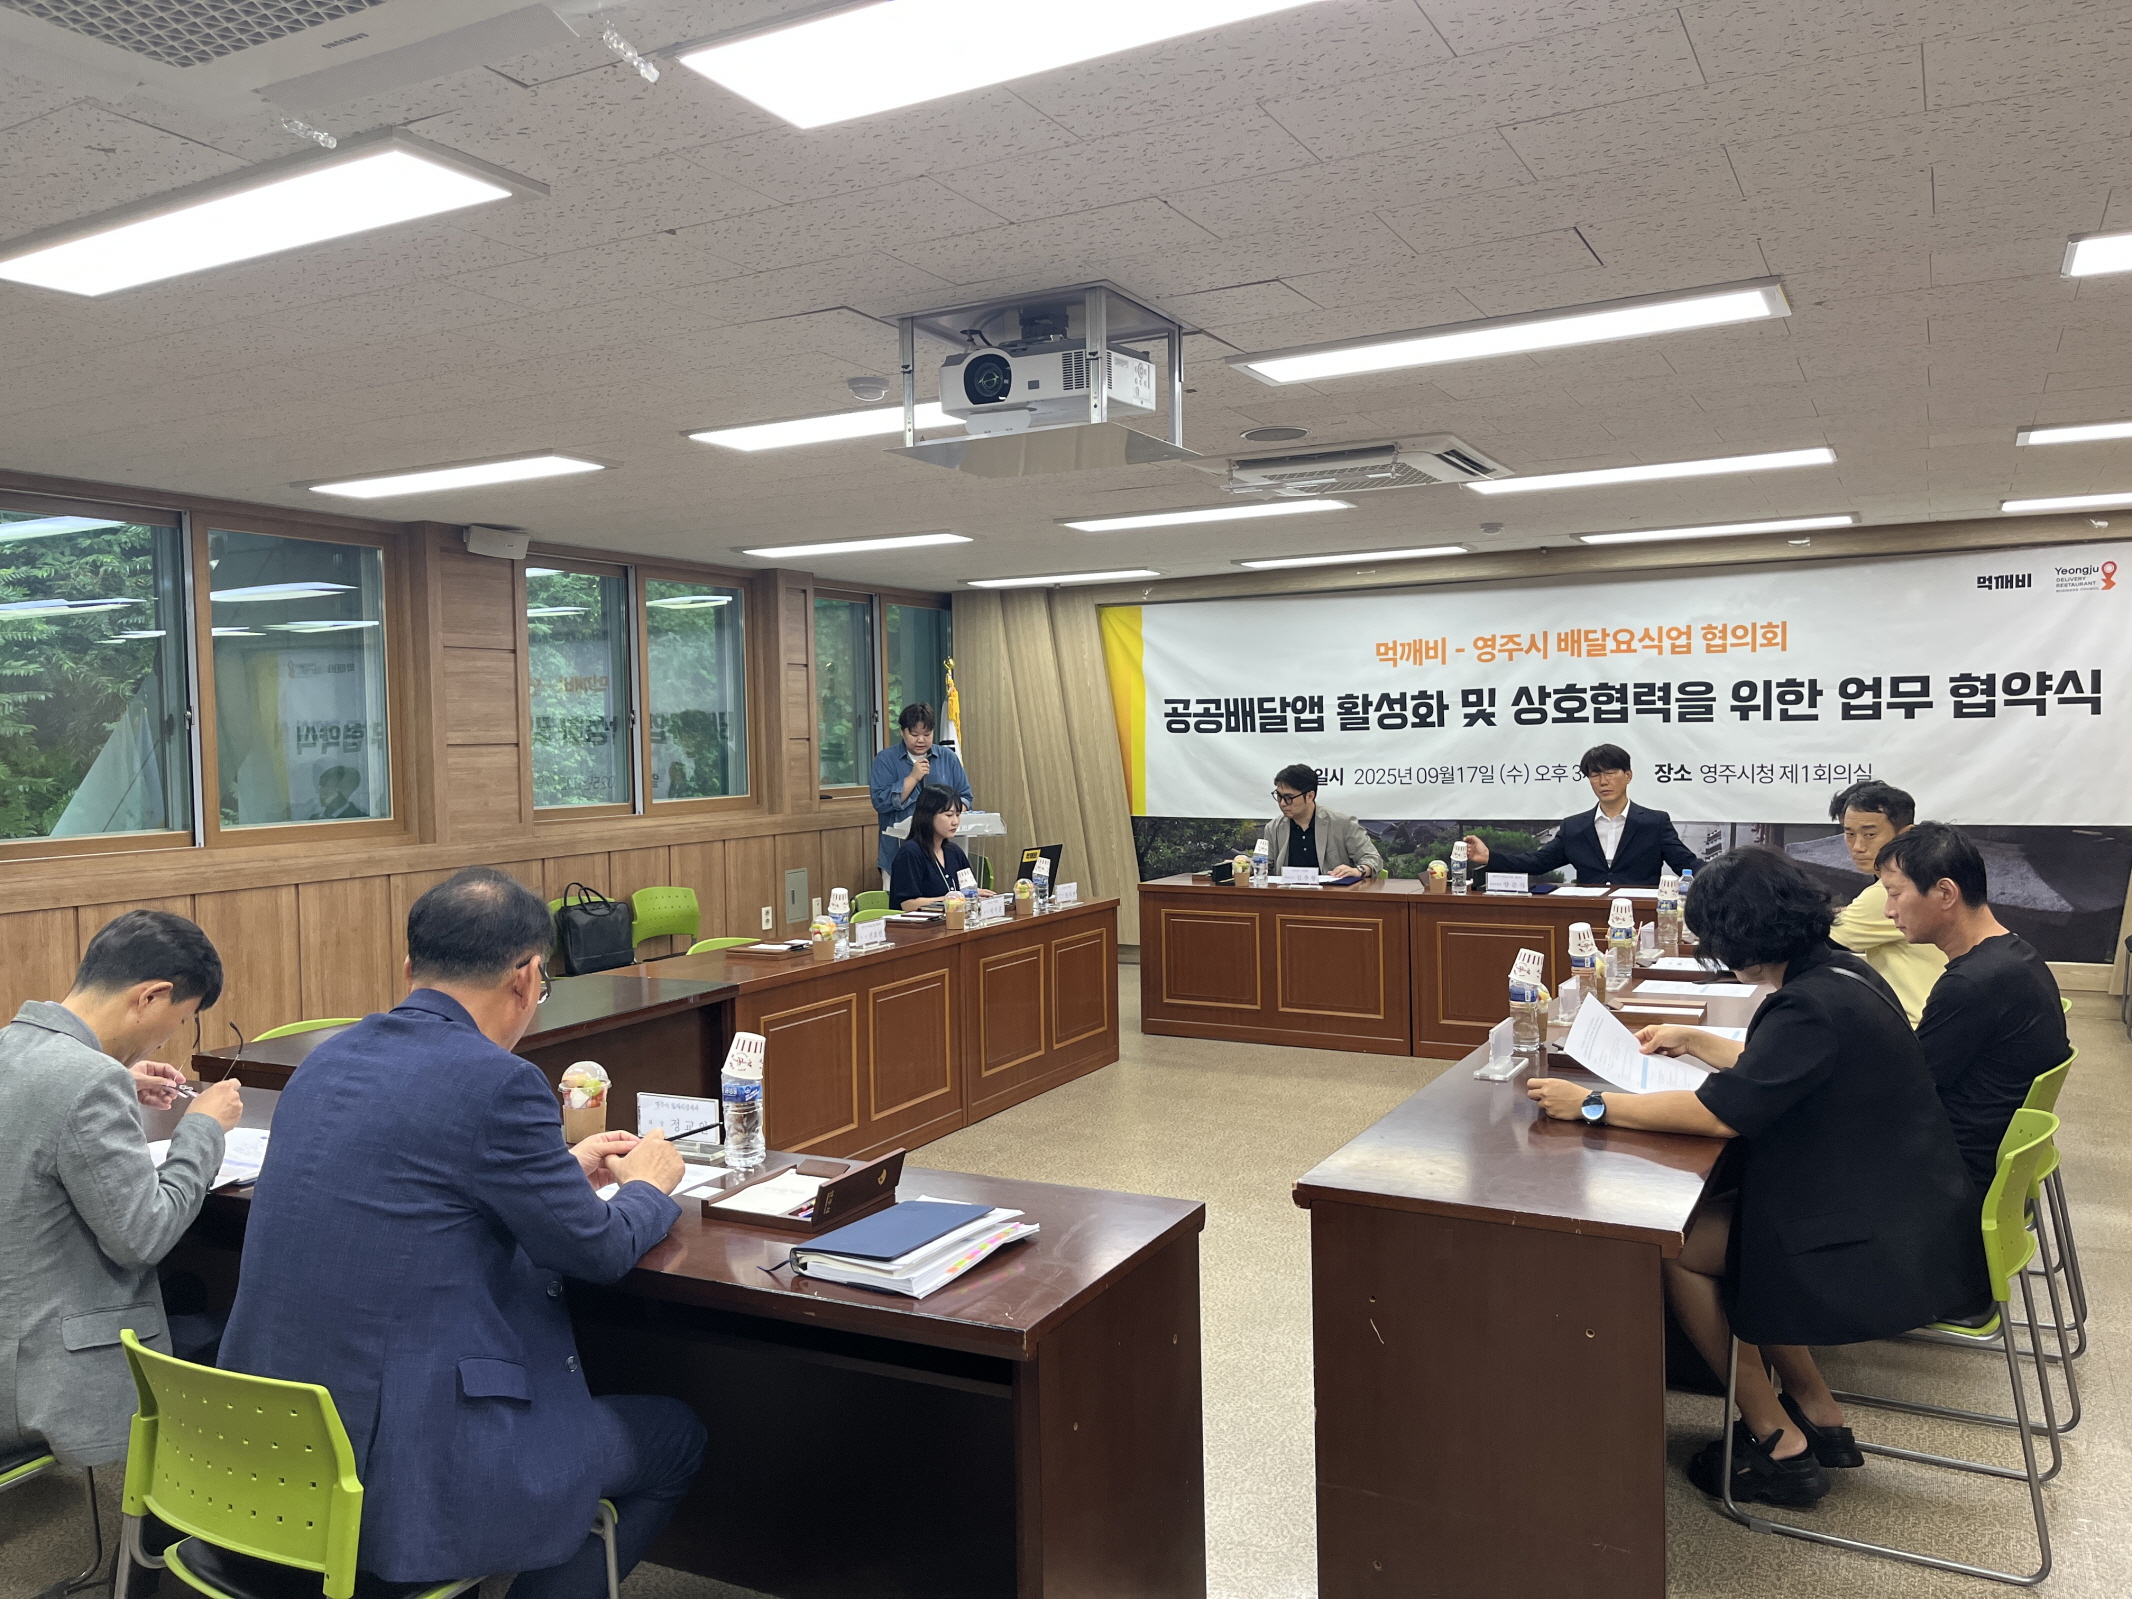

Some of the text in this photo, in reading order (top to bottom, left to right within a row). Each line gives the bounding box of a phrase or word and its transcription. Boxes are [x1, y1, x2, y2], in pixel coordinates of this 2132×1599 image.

[1976, 573, 2032, 590] 먹깨비
[2055, 564, 2099, 576] Yeongju
[1375, 636, 1447, 668] 먹깨비
[1472, 630, 1549, 663] 영주시
[1556, 624, 1692, 658] 배달요식업
[1701, 621, 1788, 654] 협의회
[1163, 668, 2102, 734] 공공배달앱 활성화 및 상호협력을 위한 업무 협약식
[1314, 762, 1872, 786] 일시 2025년 09월17일 (수) 오후 3 장소 영주시청 제1회의실
